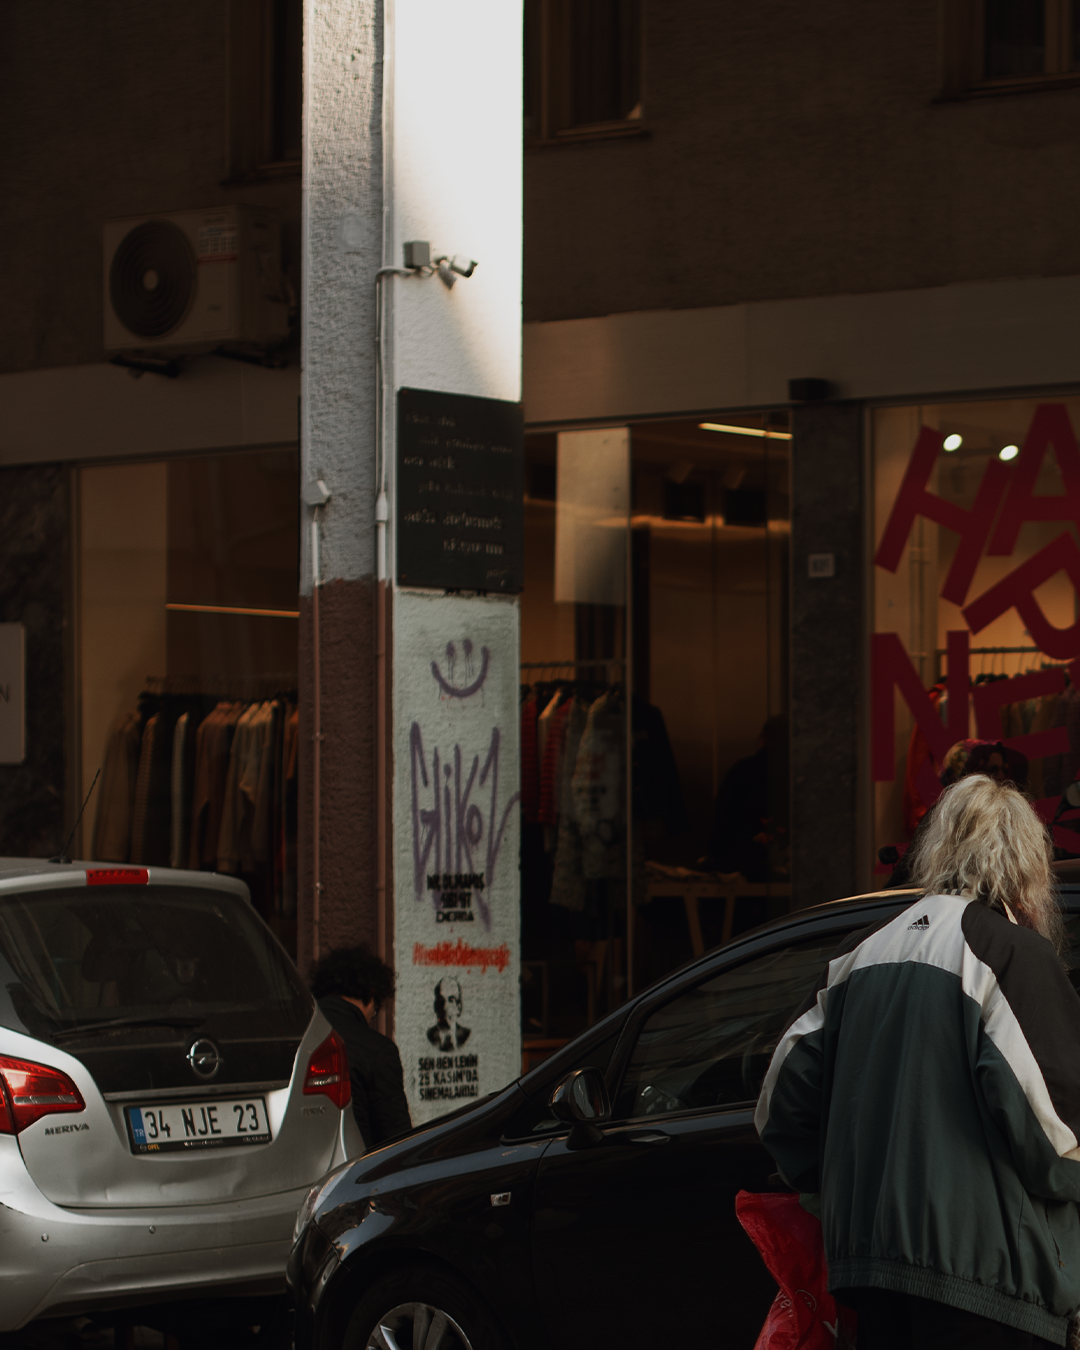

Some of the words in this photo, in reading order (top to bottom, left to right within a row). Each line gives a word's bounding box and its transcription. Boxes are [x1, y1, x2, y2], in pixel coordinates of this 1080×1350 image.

[418, 1057, 434, 1071] SEN
[436, 1055, 453, 1069] BEN
[145, 1110, 170, 1138] 34
[181, 1106, 221, 1136] NJE
[233, 1103, 259, 1132] 23
[44, 1123, 90, 1136] MERIVA
[134, 1128, 144, 1137] TR
